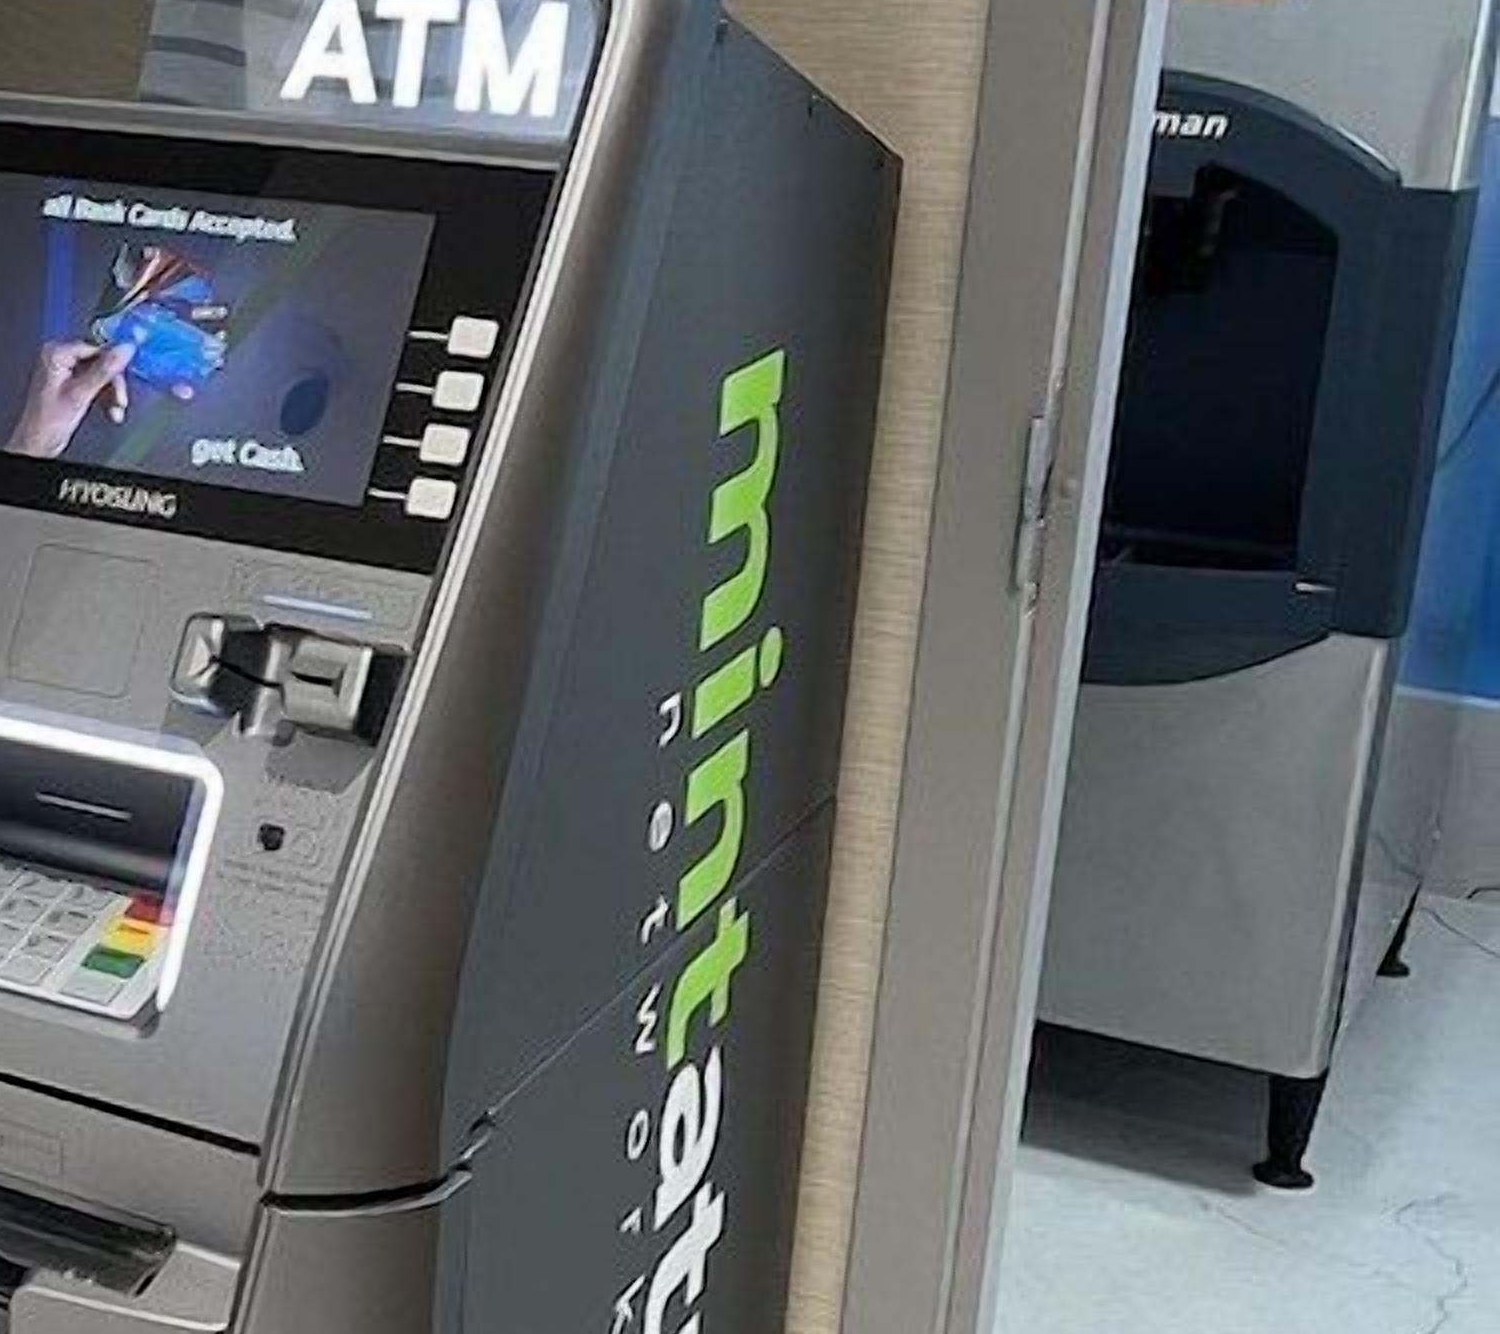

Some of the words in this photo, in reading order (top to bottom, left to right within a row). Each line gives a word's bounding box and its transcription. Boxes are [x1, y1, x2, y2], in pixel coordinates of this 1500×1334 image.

[1153, 111, 1228, 138] man
[73, 198, 126, 224] Bank
[128, 203, 190, 232] Cards
[58, 478, 178, 519] HYOSUNG
